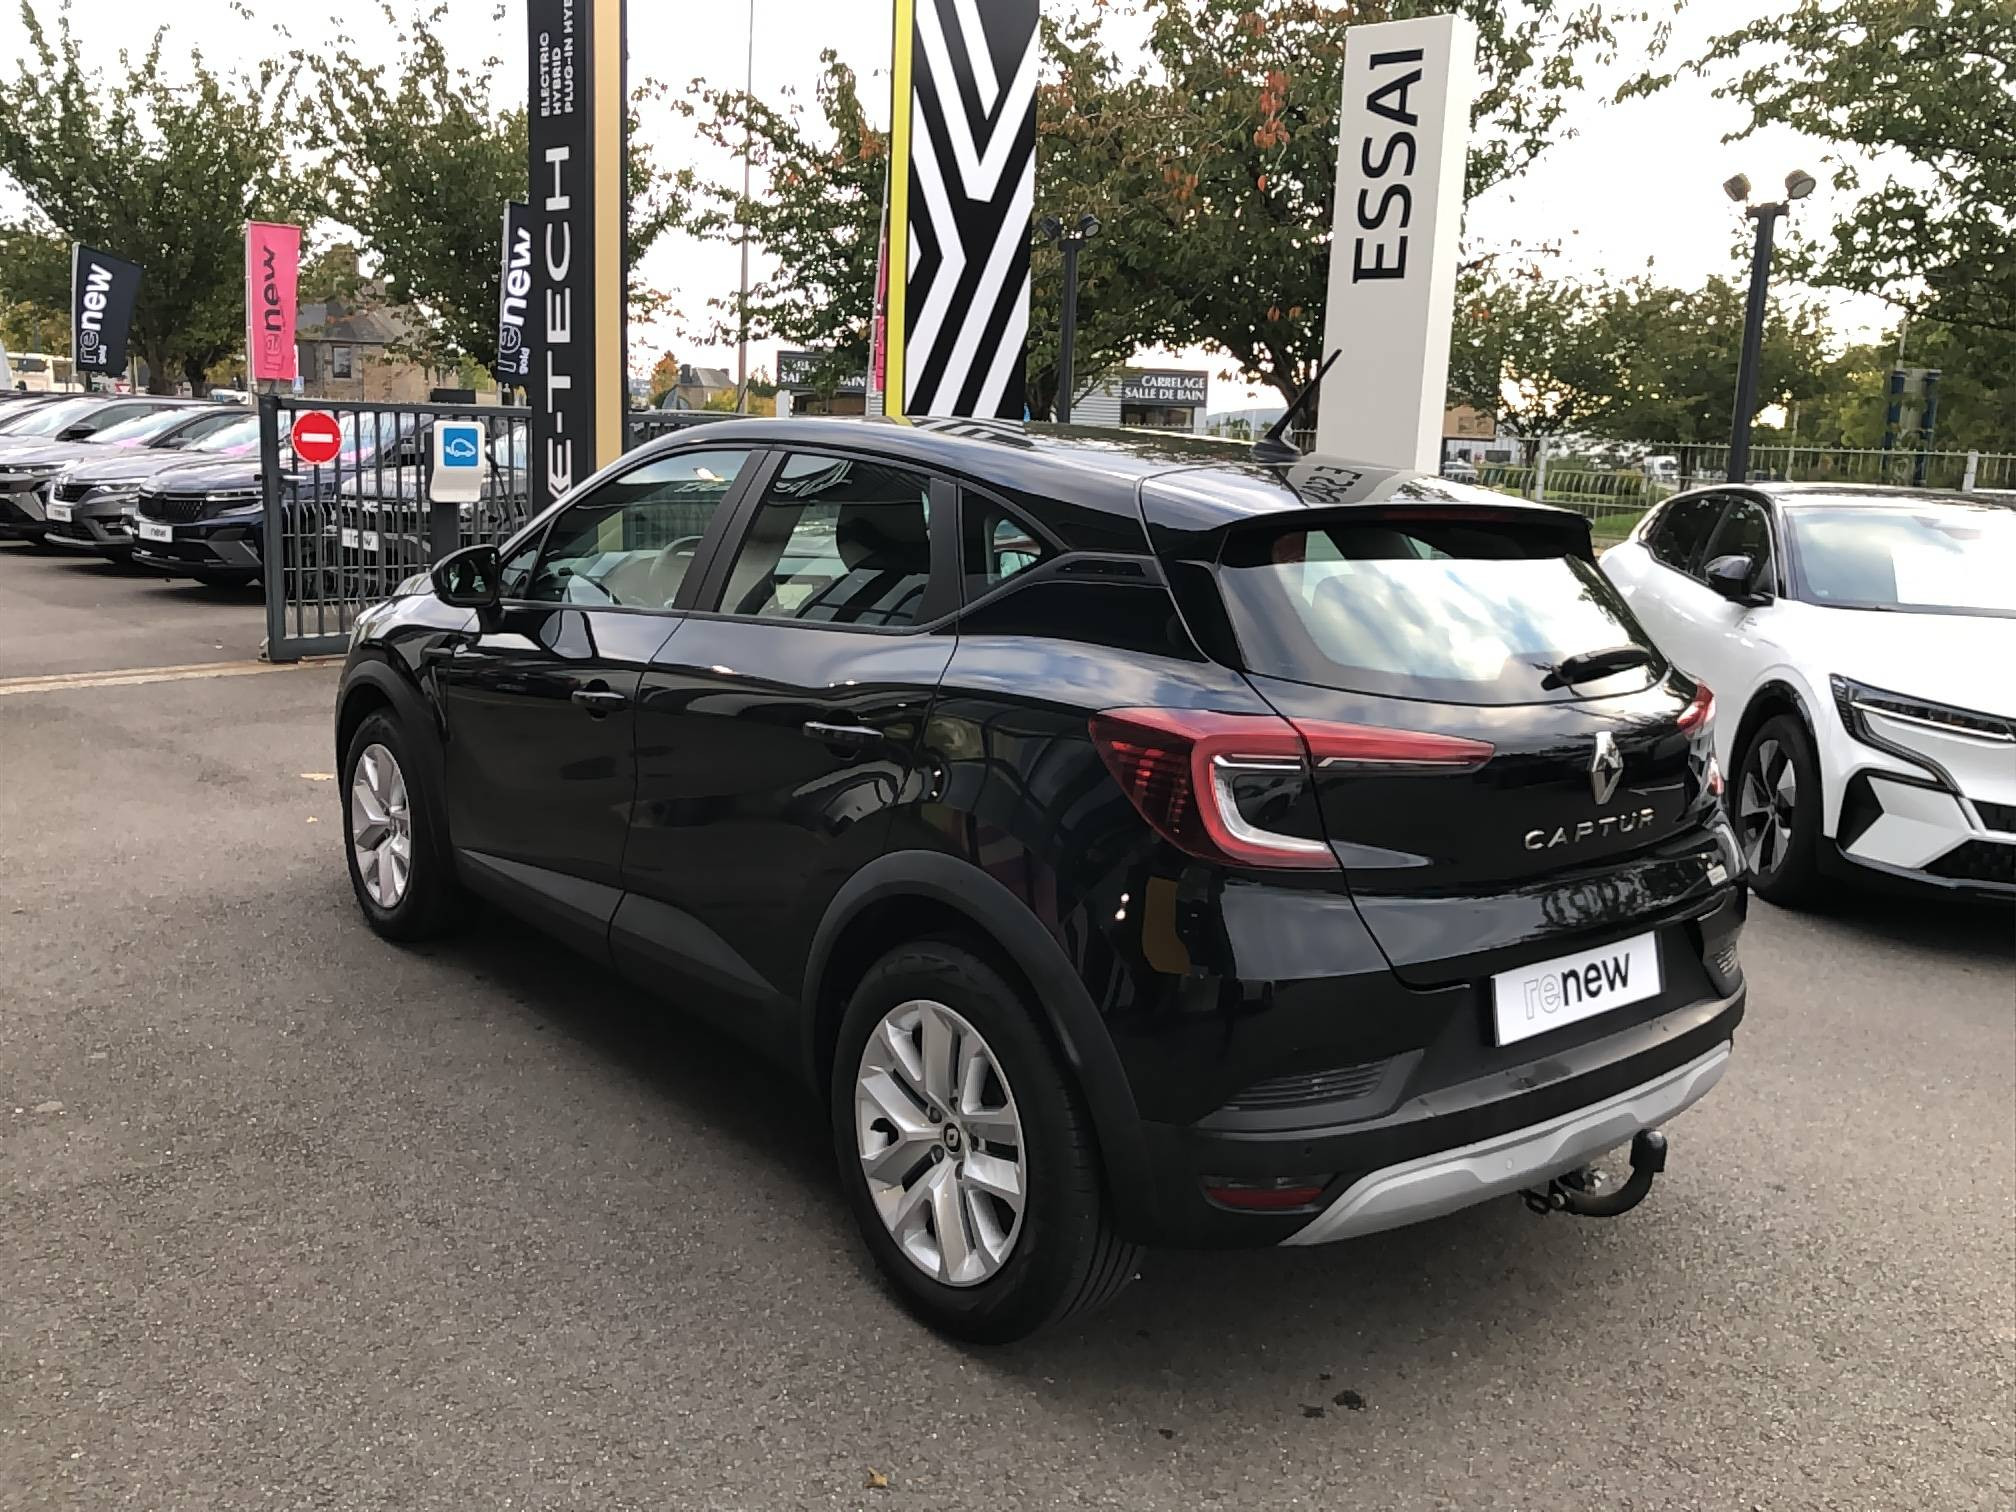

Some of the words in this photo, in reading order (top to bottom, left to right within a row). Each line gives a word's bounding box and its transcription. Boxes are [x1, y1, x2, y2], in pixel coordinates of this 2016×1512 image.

[540, 32, 550, 117] ELECTRIC
[552, 47, 561, 115] HYBRID
[564, 38, 573, 113] PLUG-IN
[1352, 48, 1424, 284] ESSAI
[80, 263, 112, 364] renew
[263, 246, 283, 372] renew
[495, 227, 531, 373] renew
[546, 146, 572, 500] E-TECH
[519, 347, 530, 375] gold
[1124, 387, 1157, 399] SALLE
[1160, 388, 1174, 399] DE
[1177, 389, 1205, 400] BAIN
[1141, 376, 1206, 388] CARRELAGE
[1525, 808, 1655, 850] CAPTUR
[1523, 952, 1631, 1021] renew
